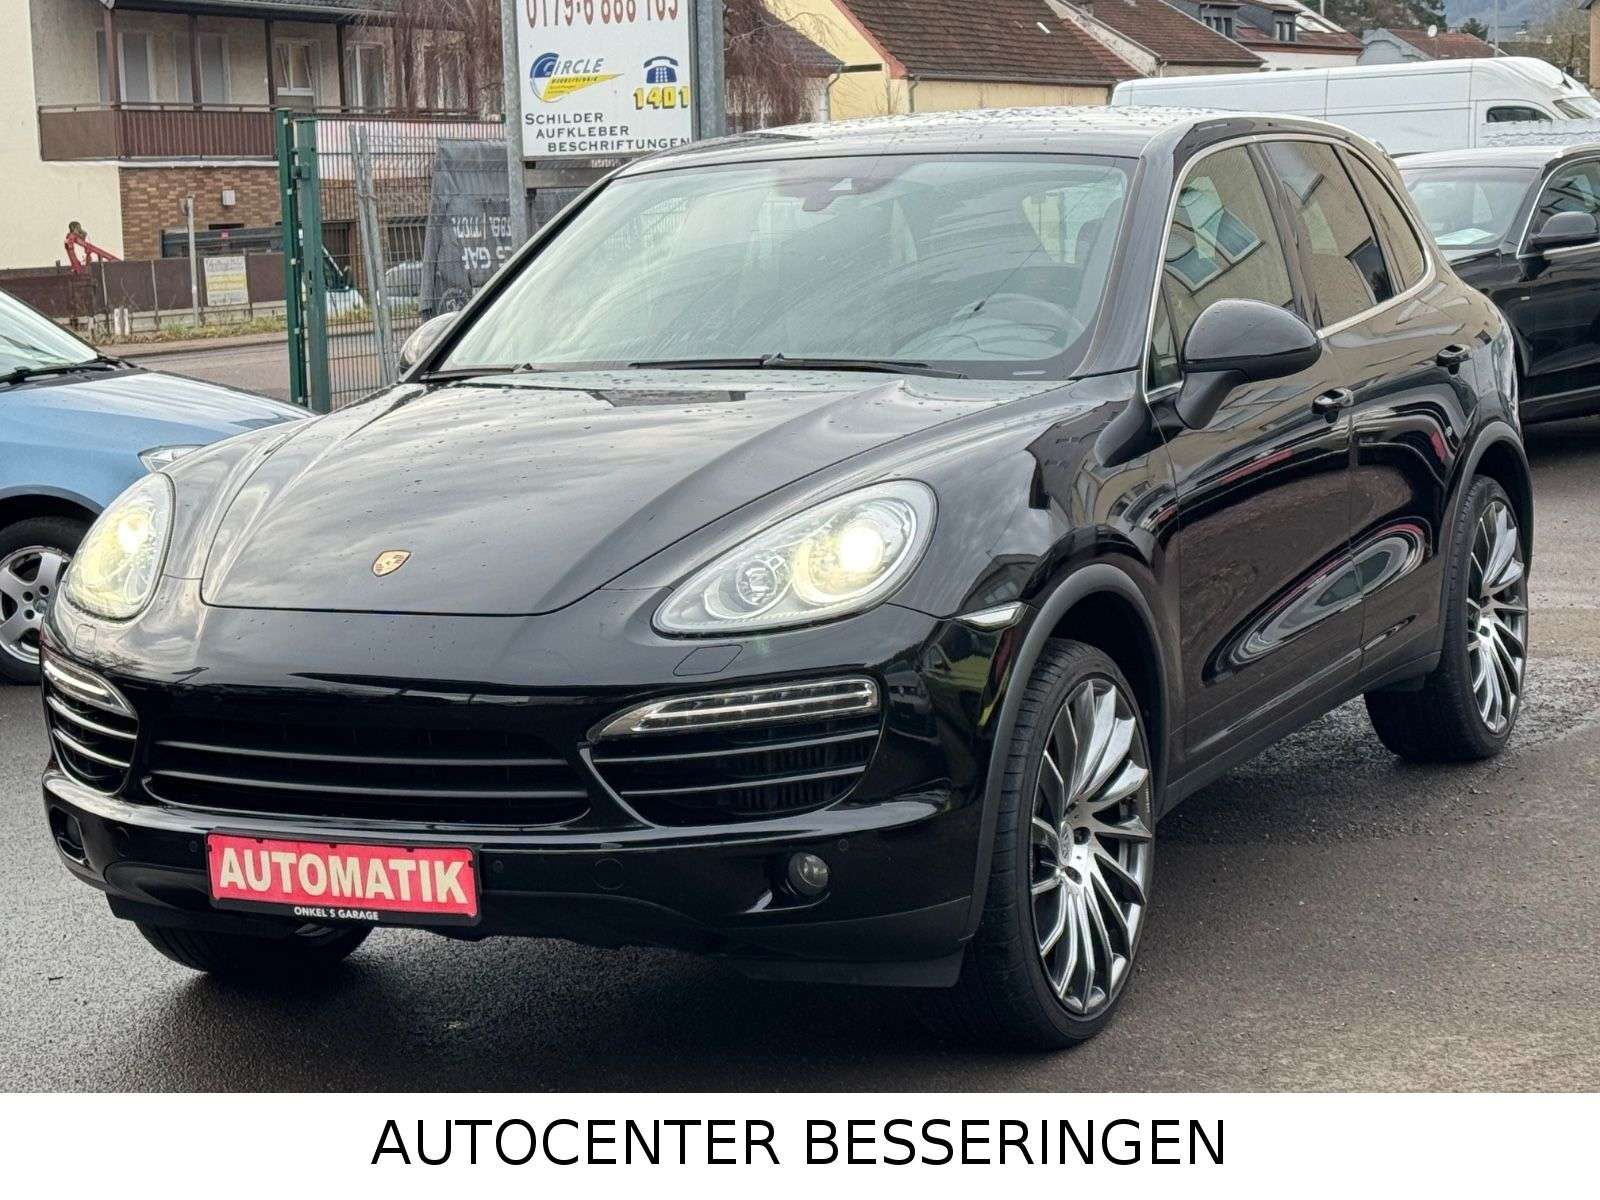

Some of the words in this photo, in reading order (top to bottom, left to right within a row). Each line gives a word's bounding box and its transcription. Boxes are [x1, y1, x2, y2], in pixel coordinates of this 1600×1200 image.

[525, 113, 603, 125] SCHILDER
[536, 126, 630, 139] AUFKLEBER
[219, 847, 468, 904] AUTOMATIK
[338, 910, 379, 921] GARAGE
